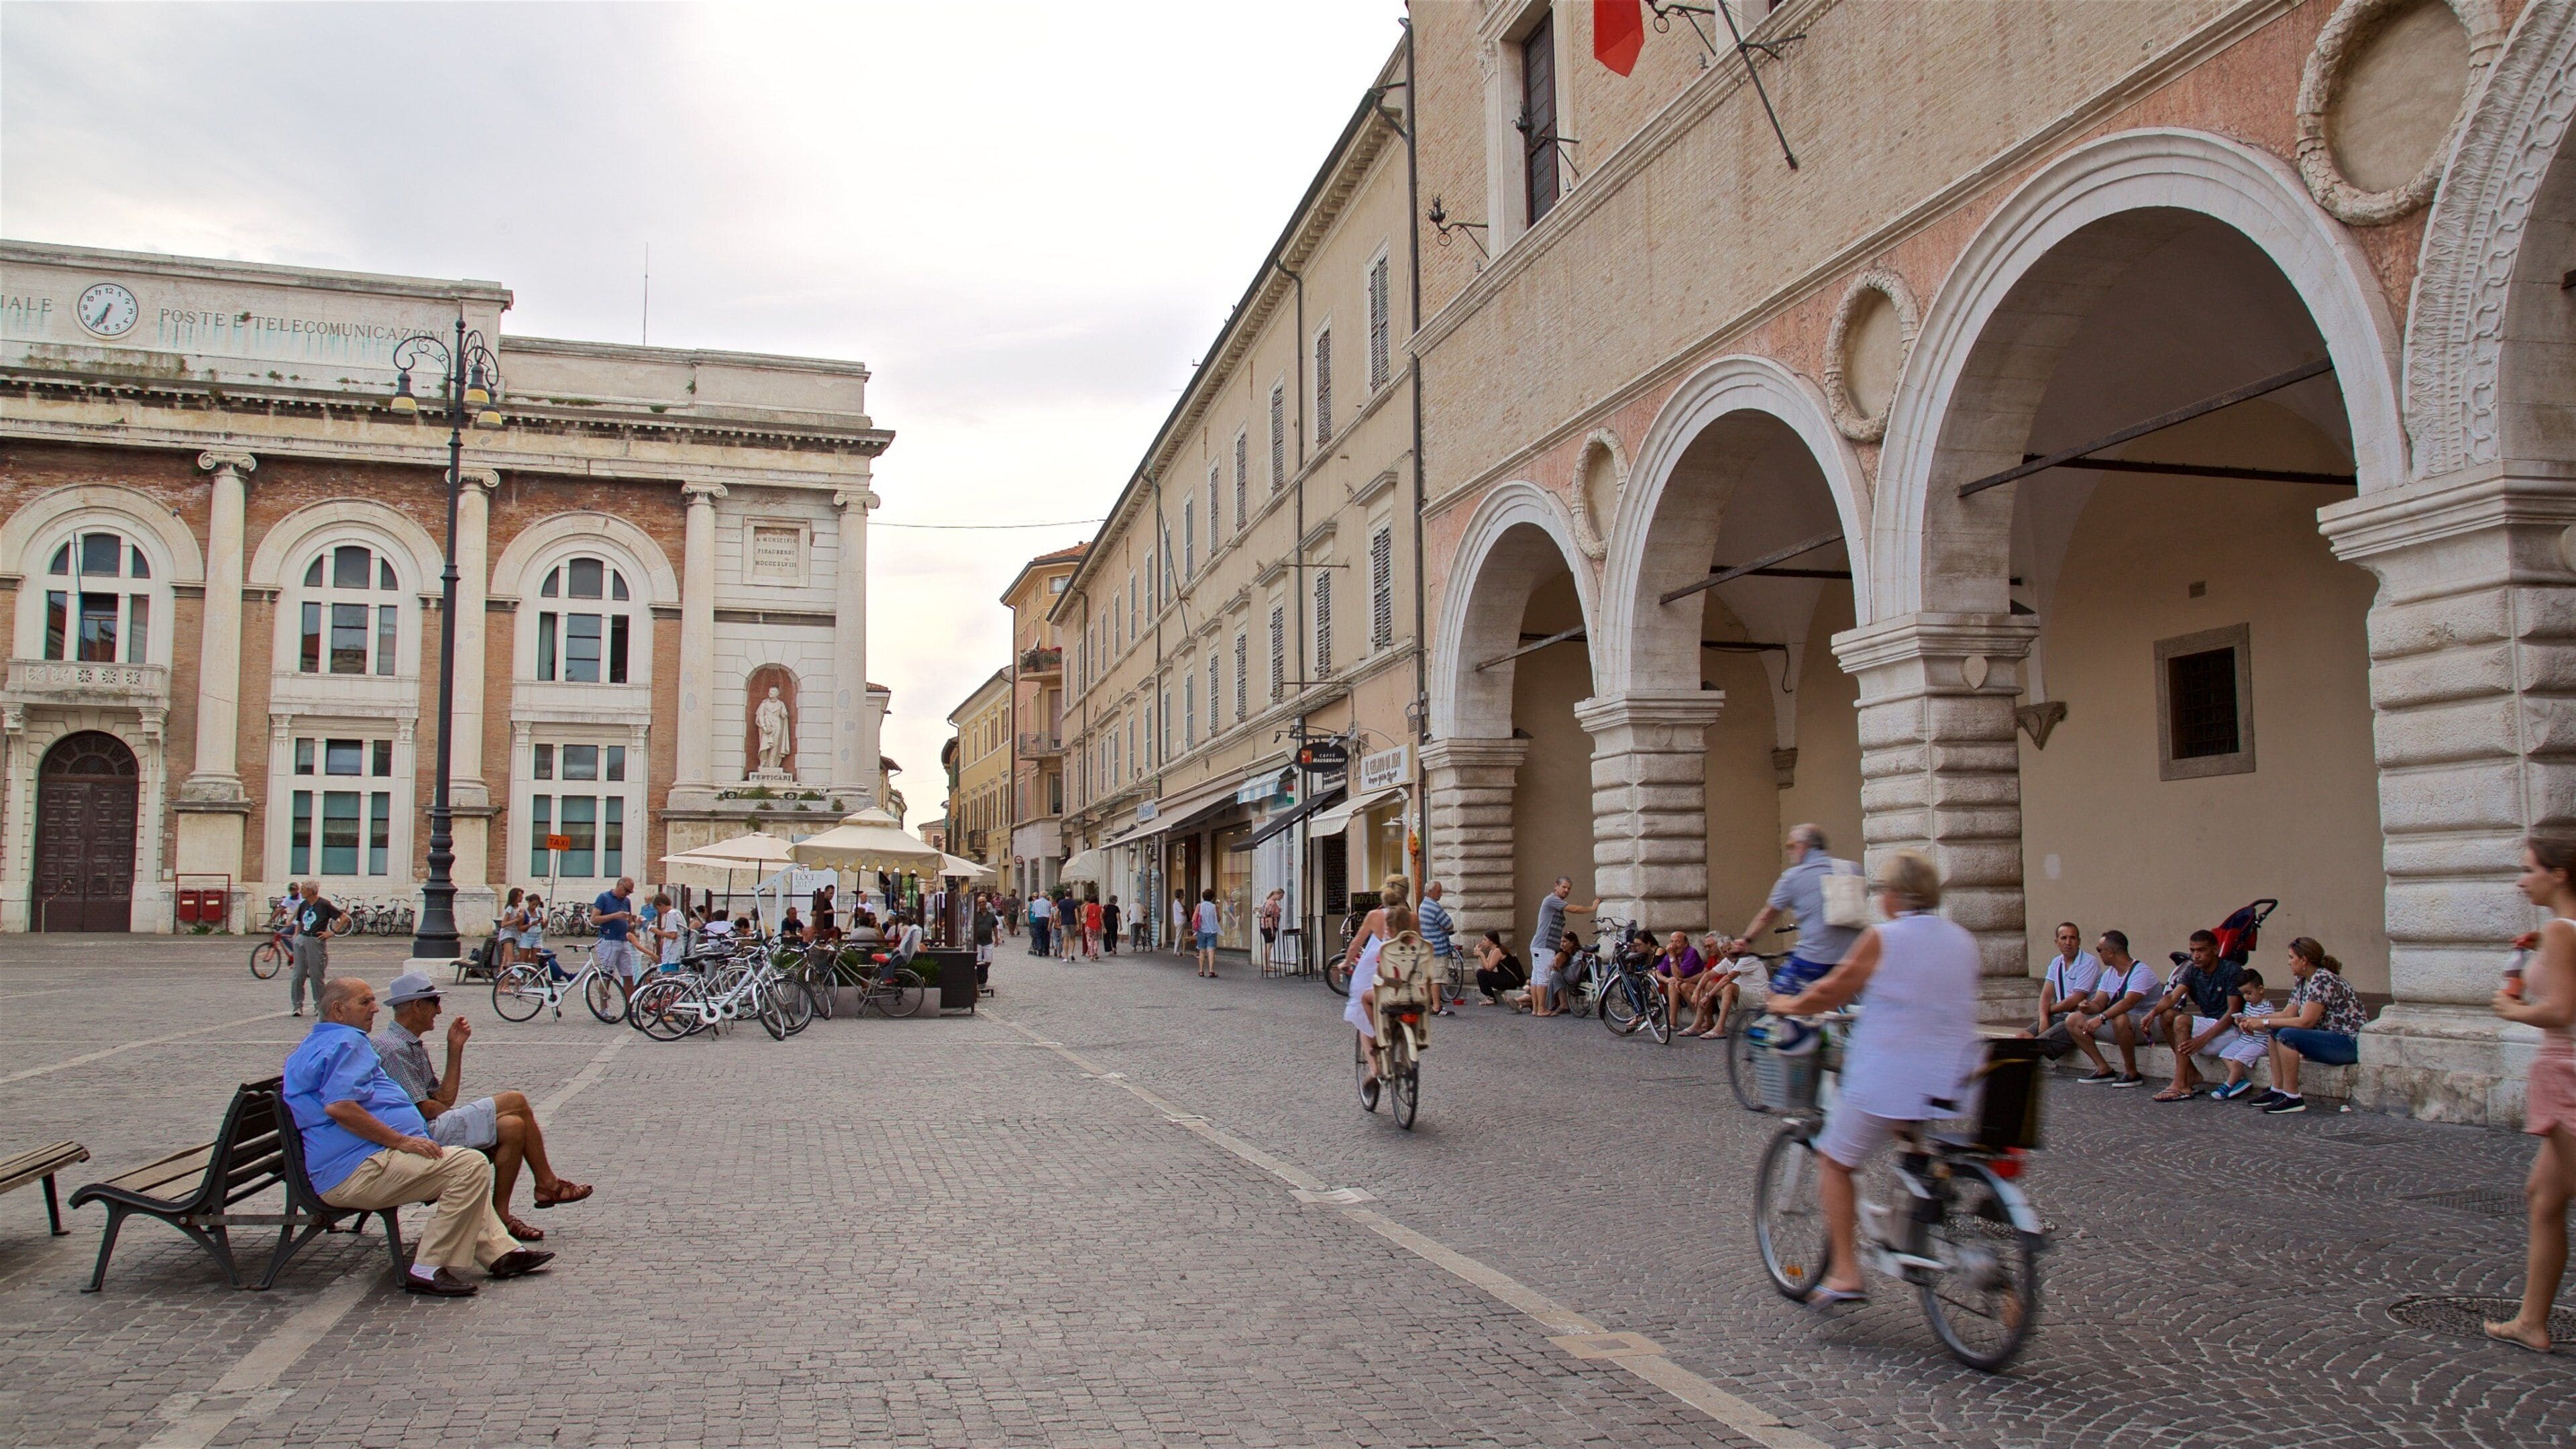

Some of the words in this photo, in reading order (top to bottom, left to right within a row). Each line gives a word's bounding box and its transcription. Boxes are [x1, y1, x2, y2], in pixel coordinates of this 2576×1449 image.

[160, 308, 226, 327] POSTE
[233, 314, 245, 328] E
[252, 316, 445, 344] TELECOMUNICAZIONI
